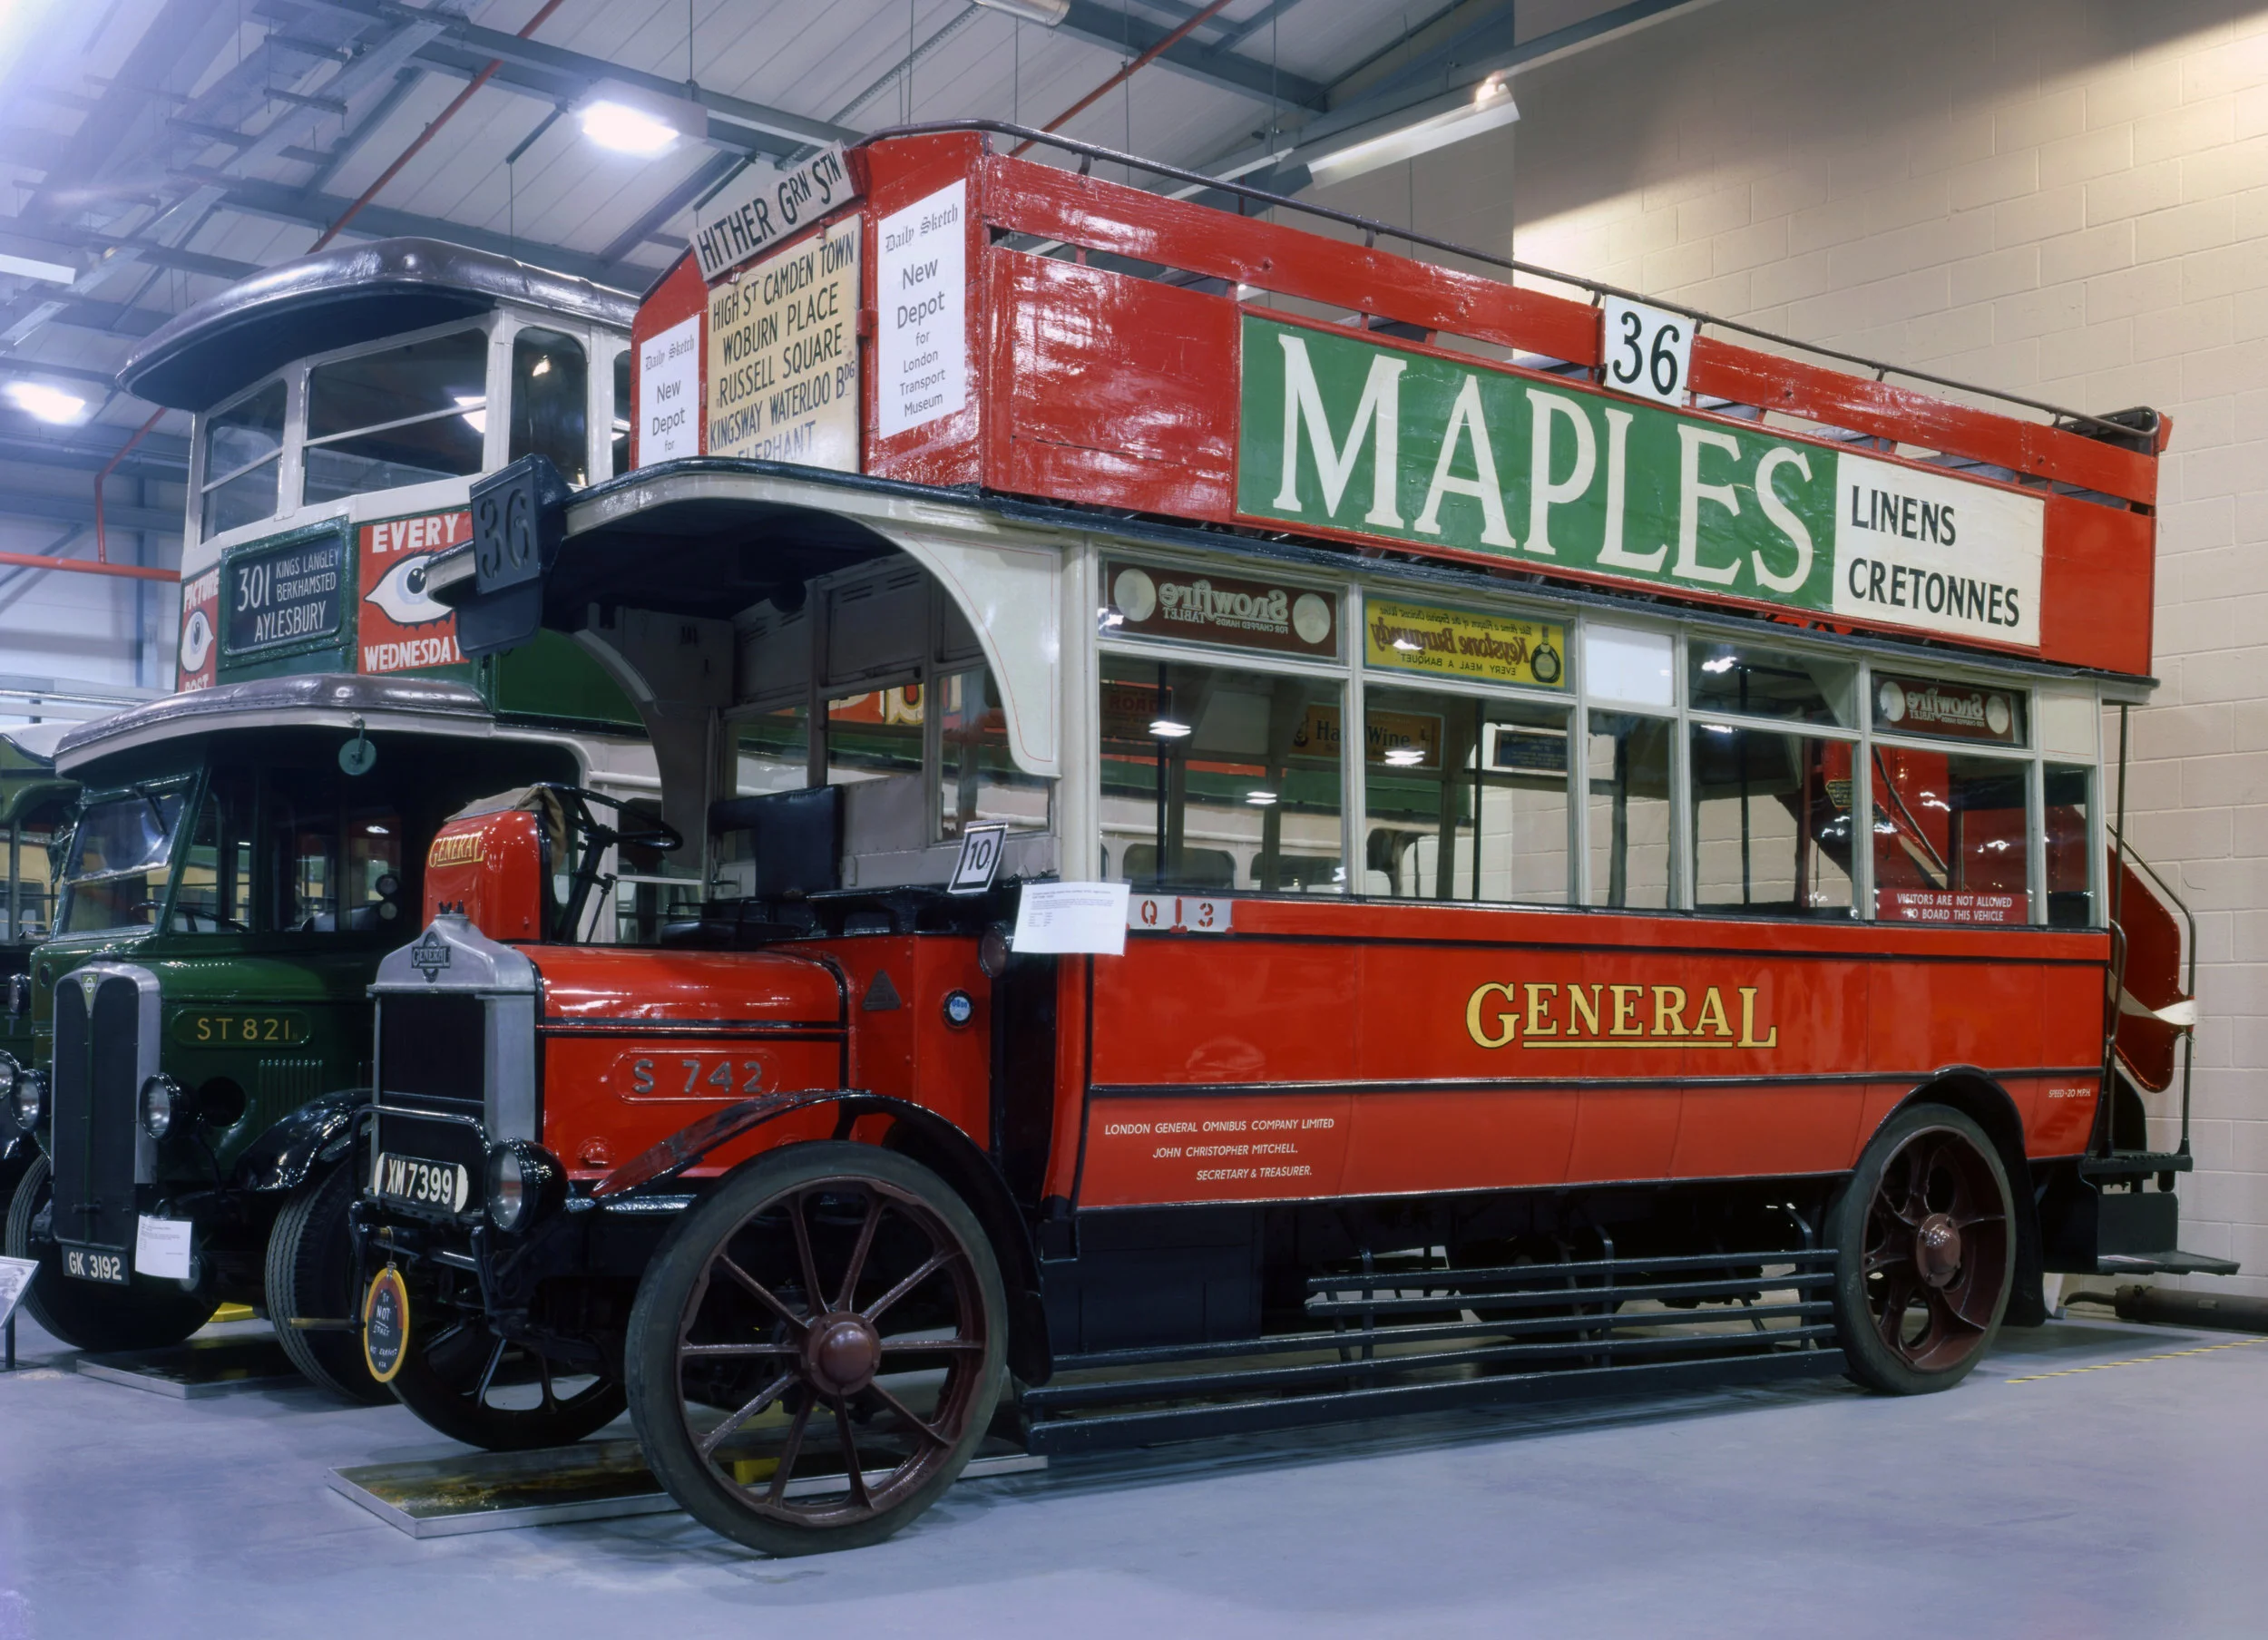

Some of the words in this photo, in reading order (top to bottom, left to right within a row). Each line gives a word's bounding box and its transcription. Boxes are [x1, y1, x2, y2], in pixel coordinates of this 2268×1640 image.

[697, 198, 776, 272] HITHER
[885, 226, 914, 253] Daily
[920, 203, 958, 236] Sketch
[713, 291, 738, 332] HIGH
[764, 252, 814, 305] CAMDEN
[820, 231, 853, 278] TOWN
[902, 259, 938, 290] New
[723, 312, 777, 366] WOBURN
[787, 282, 838, 336] PLACE
[897, 291, 944, 329] Depot
[645, 349, 665, 371] Daily
[669, 335, 694, 360] Sketch
[915, 330, 930, 346] for
[1612, 311, 1680, 395] 36
[719, 356, 775, 407] RUSSELL
[783, 323, 842, 378] SQUARE
[904, 349, 938, 374] London
[657, 379, 680, 404] New
[900, 368, 945, 396] Transport
[652, 407, 685, 436] Depot
[710, 401, 762, 452] KINGSWAY
[770, 372, 830, 425] WATERLOO
[904, 393, 943, 417] Museum
[664, 440, 674, 452] for
[1273, 334, 1813, 593] MAPLES
[1851, 485, 1956, 546] LINENS
[372, 513, 459, 552] EVERY
[480, 488, 531, 579] 36
[276, 557, 299, 579] KINGS
[303, 547, 338, 572] LANGLEY
[184, 567, 219, 612] PICTURE
[238, 563, 270, 611] 301
[277, 571, 336, 601] BERKHAMSTED
[1849, 558, 2019, 628] CRETONNES
[254, 600, 326, 642] AYLESBURY
[1367, 725, 1411, 747] Wine
[428, 830, 484, 868] GENERAL
[967, 838, 992, 870] 10
[1897, 893, 1933, 904] VISITORS
[1936, 895, 1951, 905] ARE
[1956, 895, 1974, 906] NOT
[1977, 896, 2012, 907] ALLOWED
[1922, 909, 1950, 920] BOARD
[1954, 910, 1970, 920] THIS
[1974, 911, 2003, 921] VEHICLE
[412, 947, 449, 967] GENERAL
[197, 1018, 233, 1040] ST
[242, 1019, 289, 1040] 821
[1465, 981, 1777, 1049] GENERAL
[633, 1059, 654, 1093] S
[682, 1059, 762, 1093] 742
[1105, 1124, 1150, 1135] LONDON
[1155, 1122, 1198, 1134] GENERAL
[1202, 1120, 1246, 1132] OMNIBUS
[1251, 1119, 1299, 1130] COMPANY
[1301, 1118, 1334, 1128] LIMITED
[1152, 1147, 1181, 1158] JOHN
[1186, 1145, 1248, 1157] CHRISTOPHER
[1252, 1143, 1298, 1155] MITCHELL.
[386, 1159, 406, 1196] XM
[406, 1163, 452, 1205] 7399
[1197, 1168, 1249, 1181] SECRETARY
[1250, 1169, 1256, 1178] &
[1259, 1166, 1312, 1177] TREASURER.
[69, 1251, 85, 1276] GK
[89, 1254, 122, 1281] 3192
[376, 1305, 390, 1321] NOT
